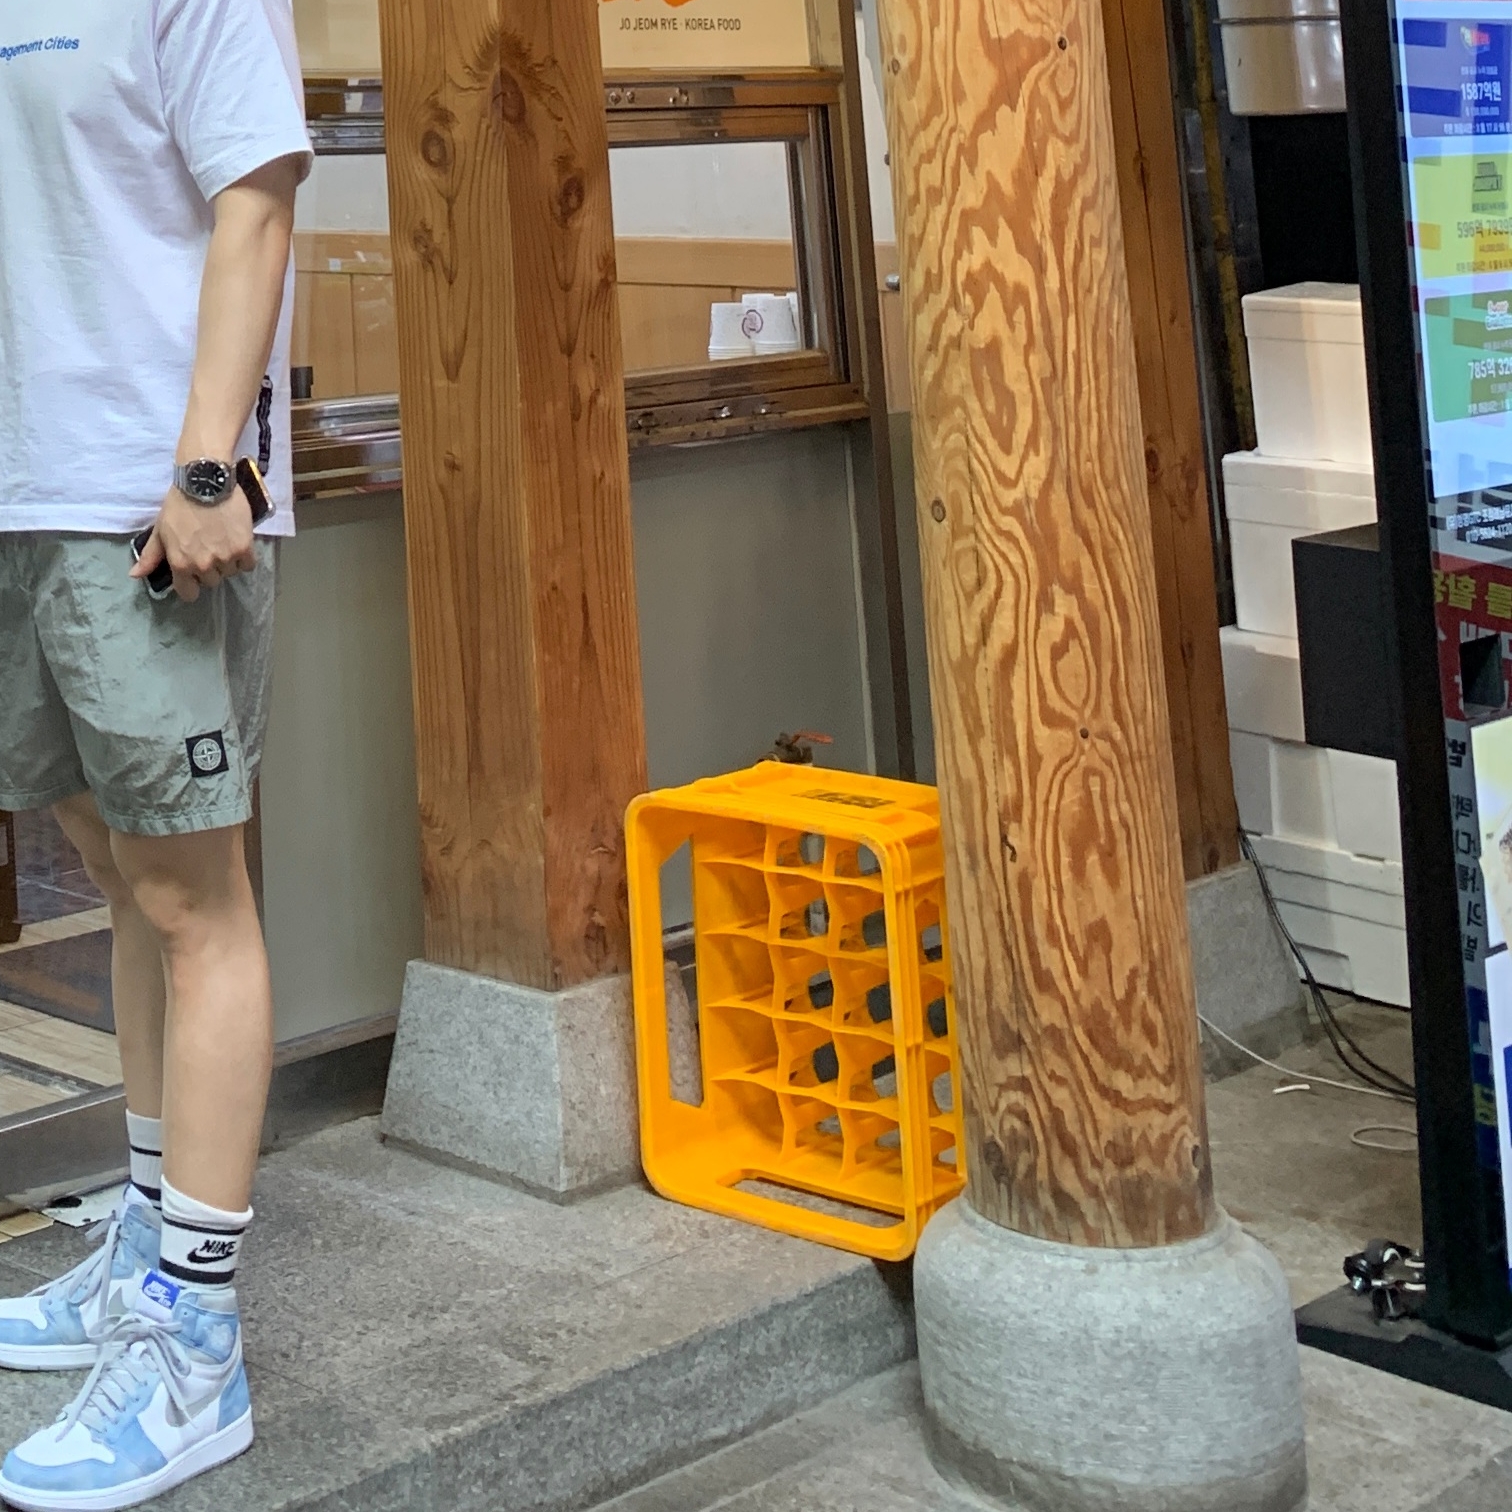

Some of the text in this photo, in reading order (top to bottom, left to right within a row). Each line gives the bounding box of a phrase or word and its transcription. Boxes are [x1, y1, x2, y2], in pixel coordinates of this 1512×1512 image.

[619, 18, 741, 31] JO JEOM RYE KOREA FOOD
[44, 36, 80, 51] Cities
[1461, 81, 1502, 101] 1587억원
[199, 1239, 237, 1255] NIKE
